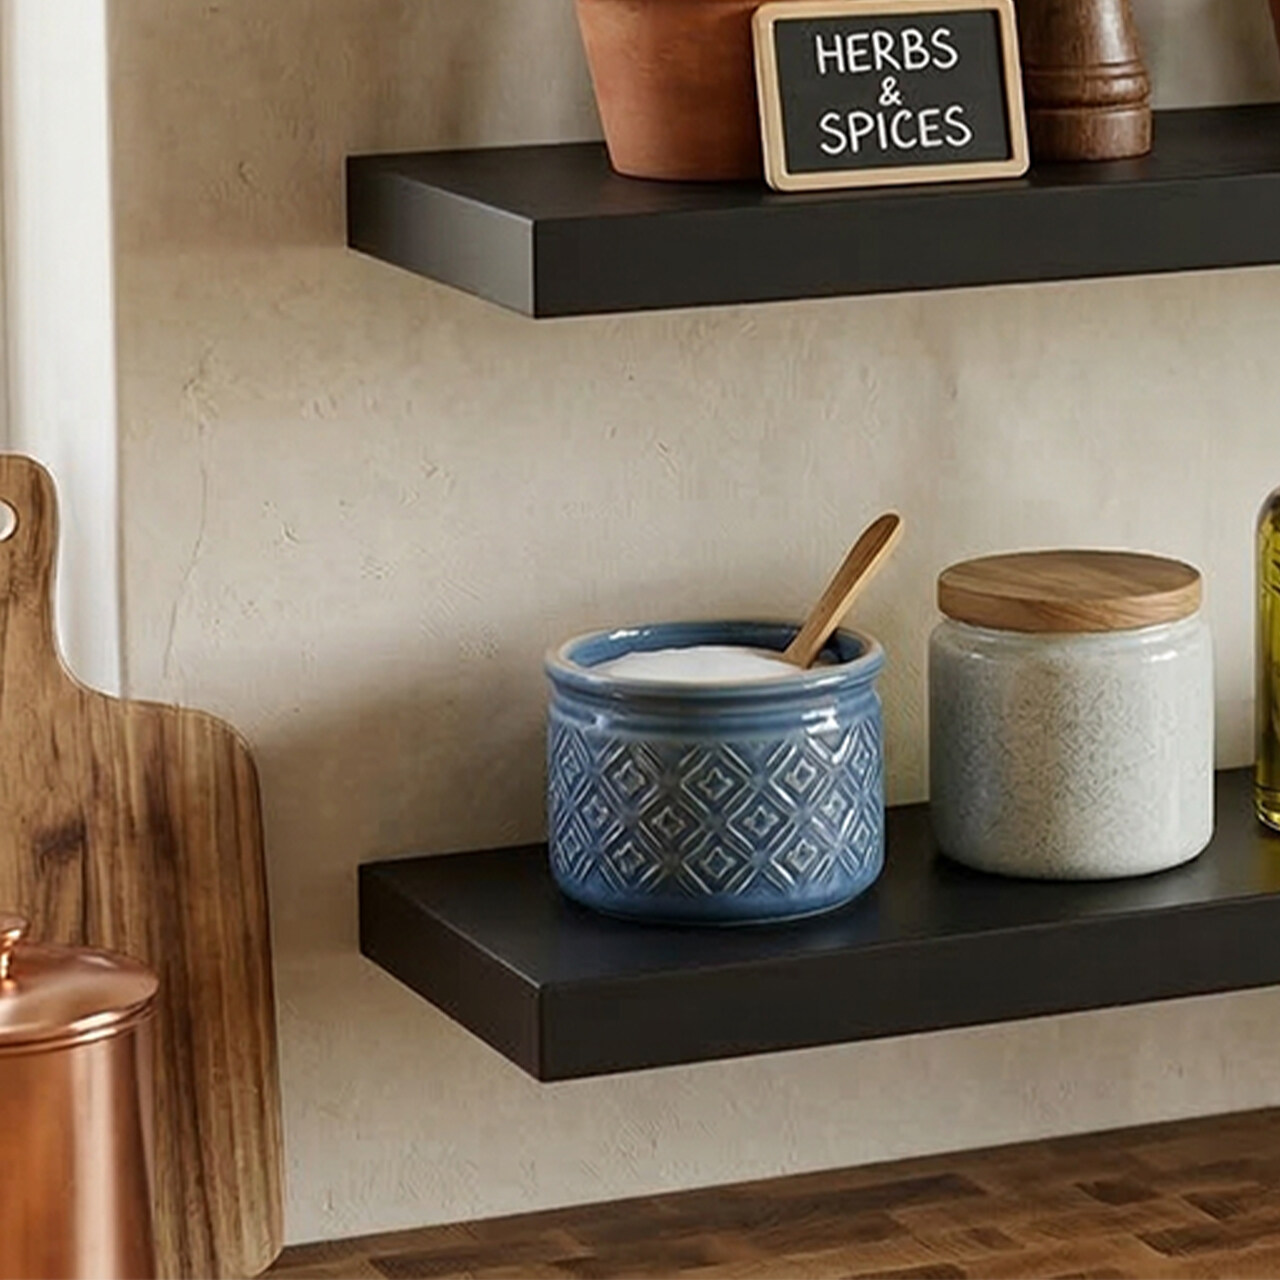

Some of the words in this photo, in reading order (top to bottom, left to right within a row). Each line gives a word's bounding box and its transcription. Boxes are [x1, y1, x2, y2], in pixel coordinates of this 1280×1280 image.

[816, 27, 958, 74] HERBS
[878, 76, 902, 106] &
[819, 105, 972, 155] SPICES
